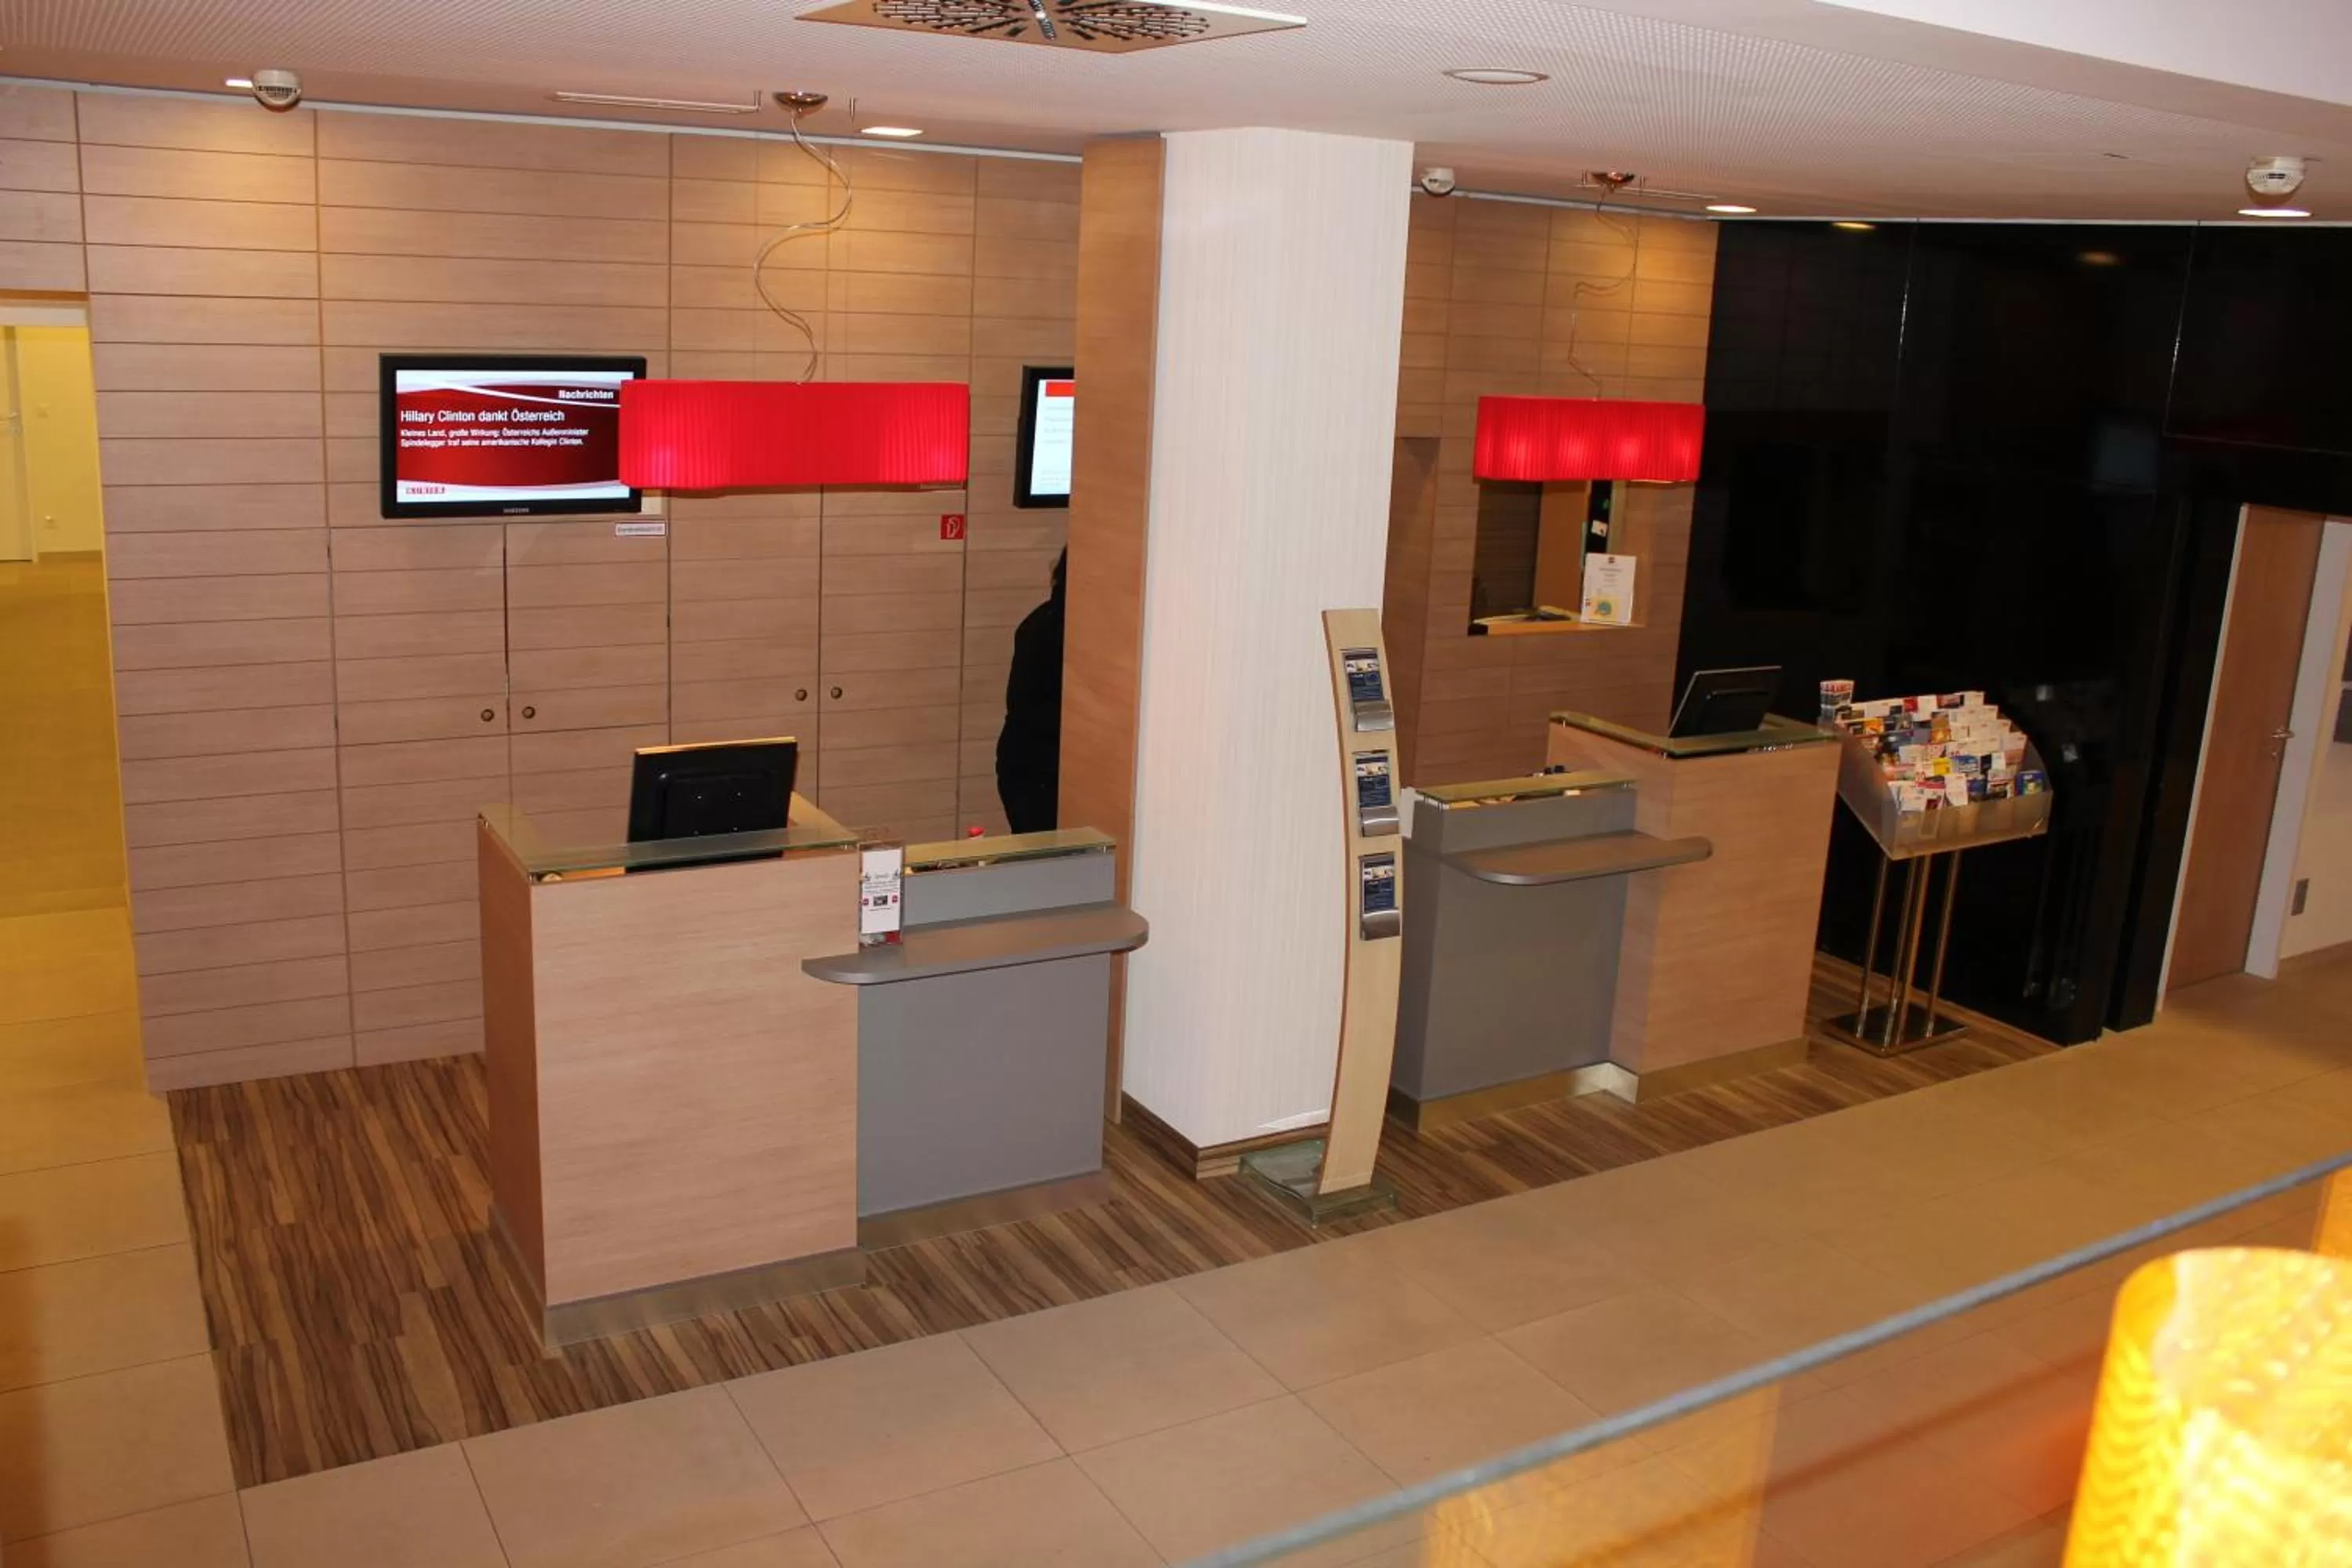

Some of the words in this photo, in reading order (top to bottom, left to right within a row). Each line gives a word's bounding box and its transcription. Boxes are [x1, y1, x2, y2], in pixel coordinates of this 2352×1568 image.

[558, 390, 614, 399] Nachrichten
[401, 410, 434, 423] Hillary
[437, 410, 475, 422] Clinton
[477, 410, 507, 422] dankt
[510, 408, 565, 422] Österreich
[427, 429, 447, 437] Land,
[503, 427, 540, 437] Österreichs
[401, 439, 445, 448] Spindelegger
